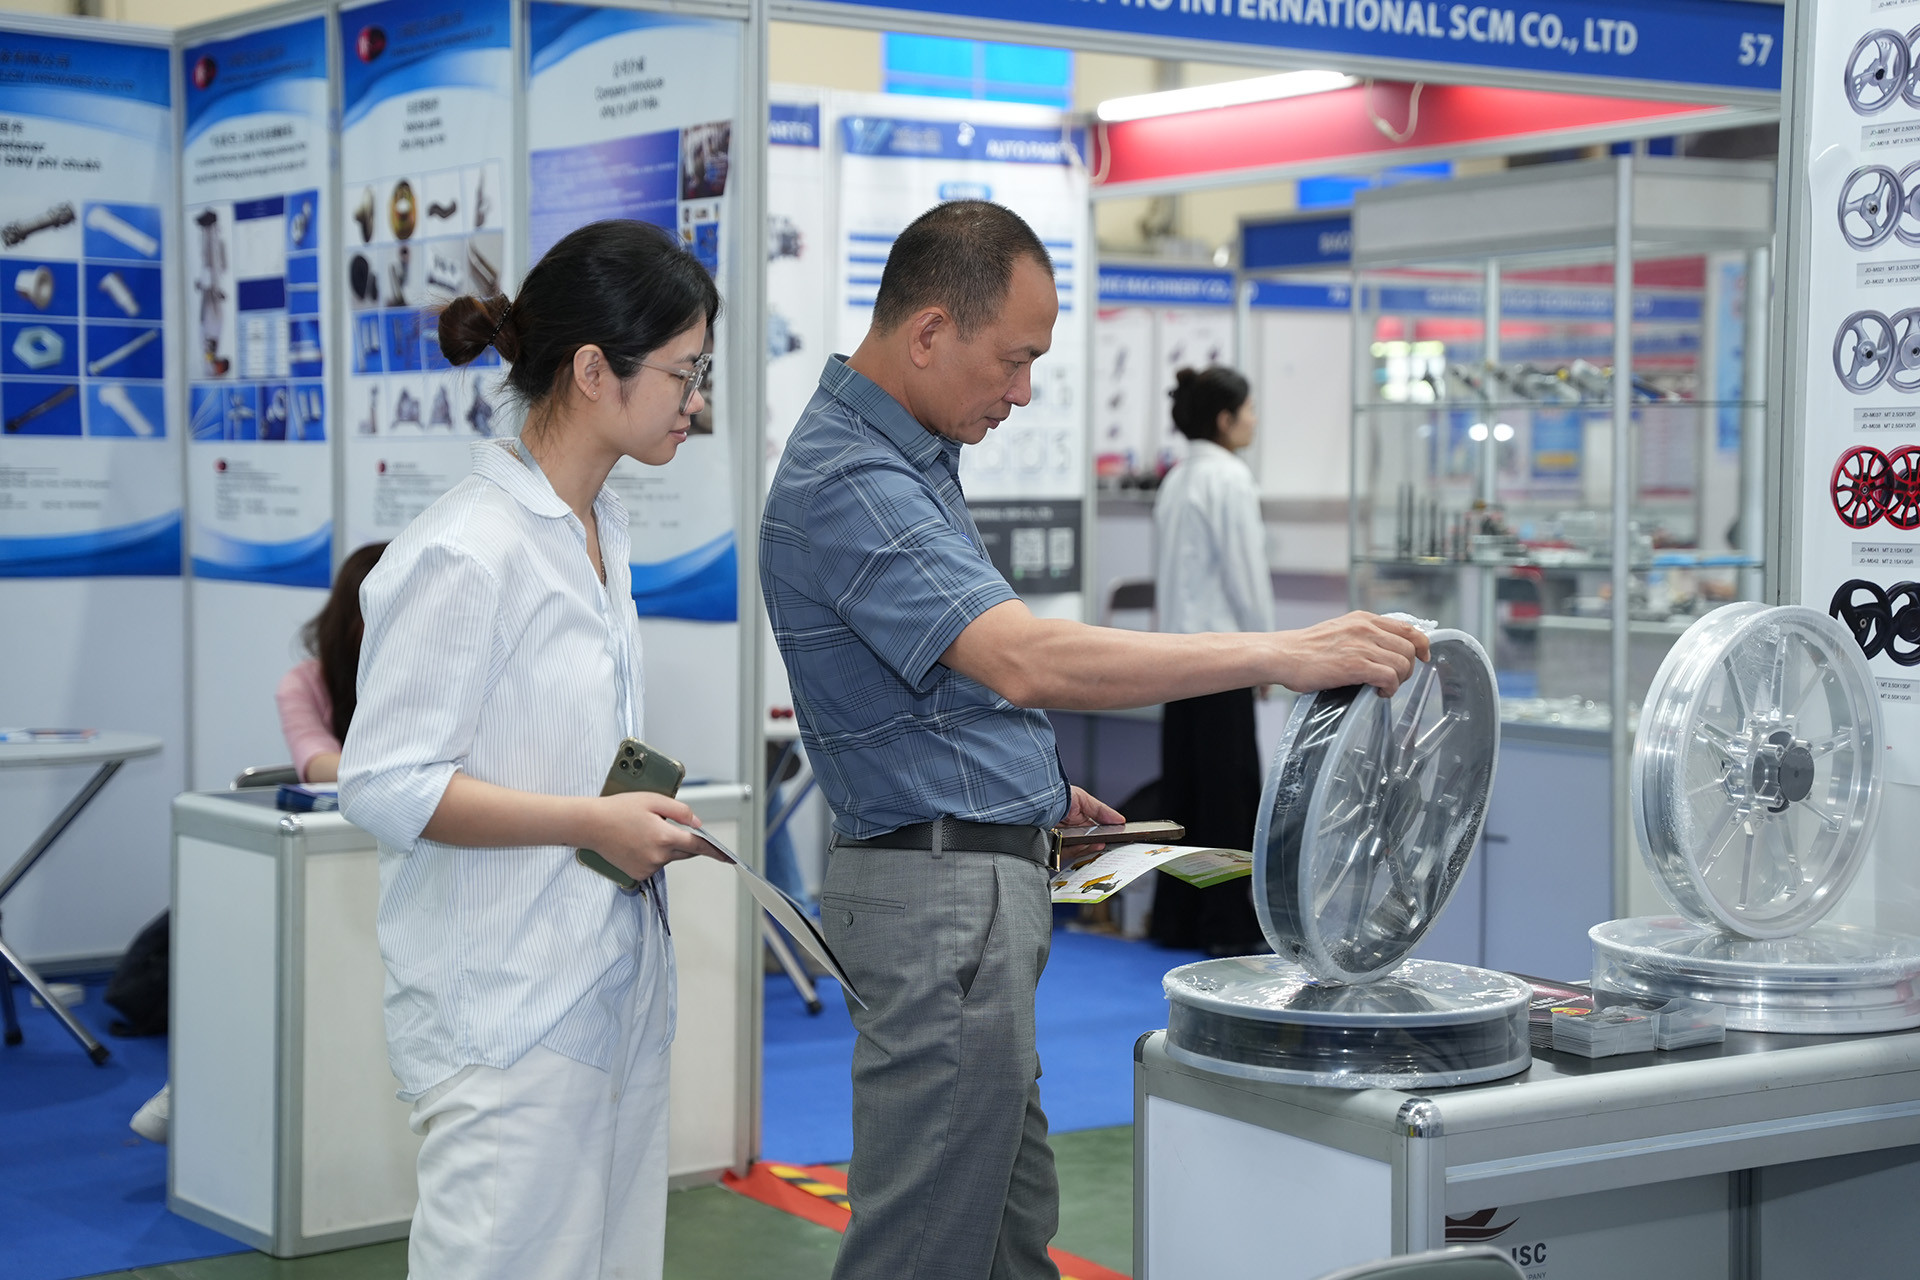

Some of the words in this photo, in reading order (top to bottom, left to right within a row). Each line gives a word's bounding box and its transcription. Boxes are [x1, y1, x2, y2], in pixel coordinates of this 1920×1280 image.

[1448, 3, 1516, 45] SCM
[1519, 11, 1580, 56] CO.,
[1583, 17, 1639, 56] LTD
[1738, 32, 1775, 67] 57
